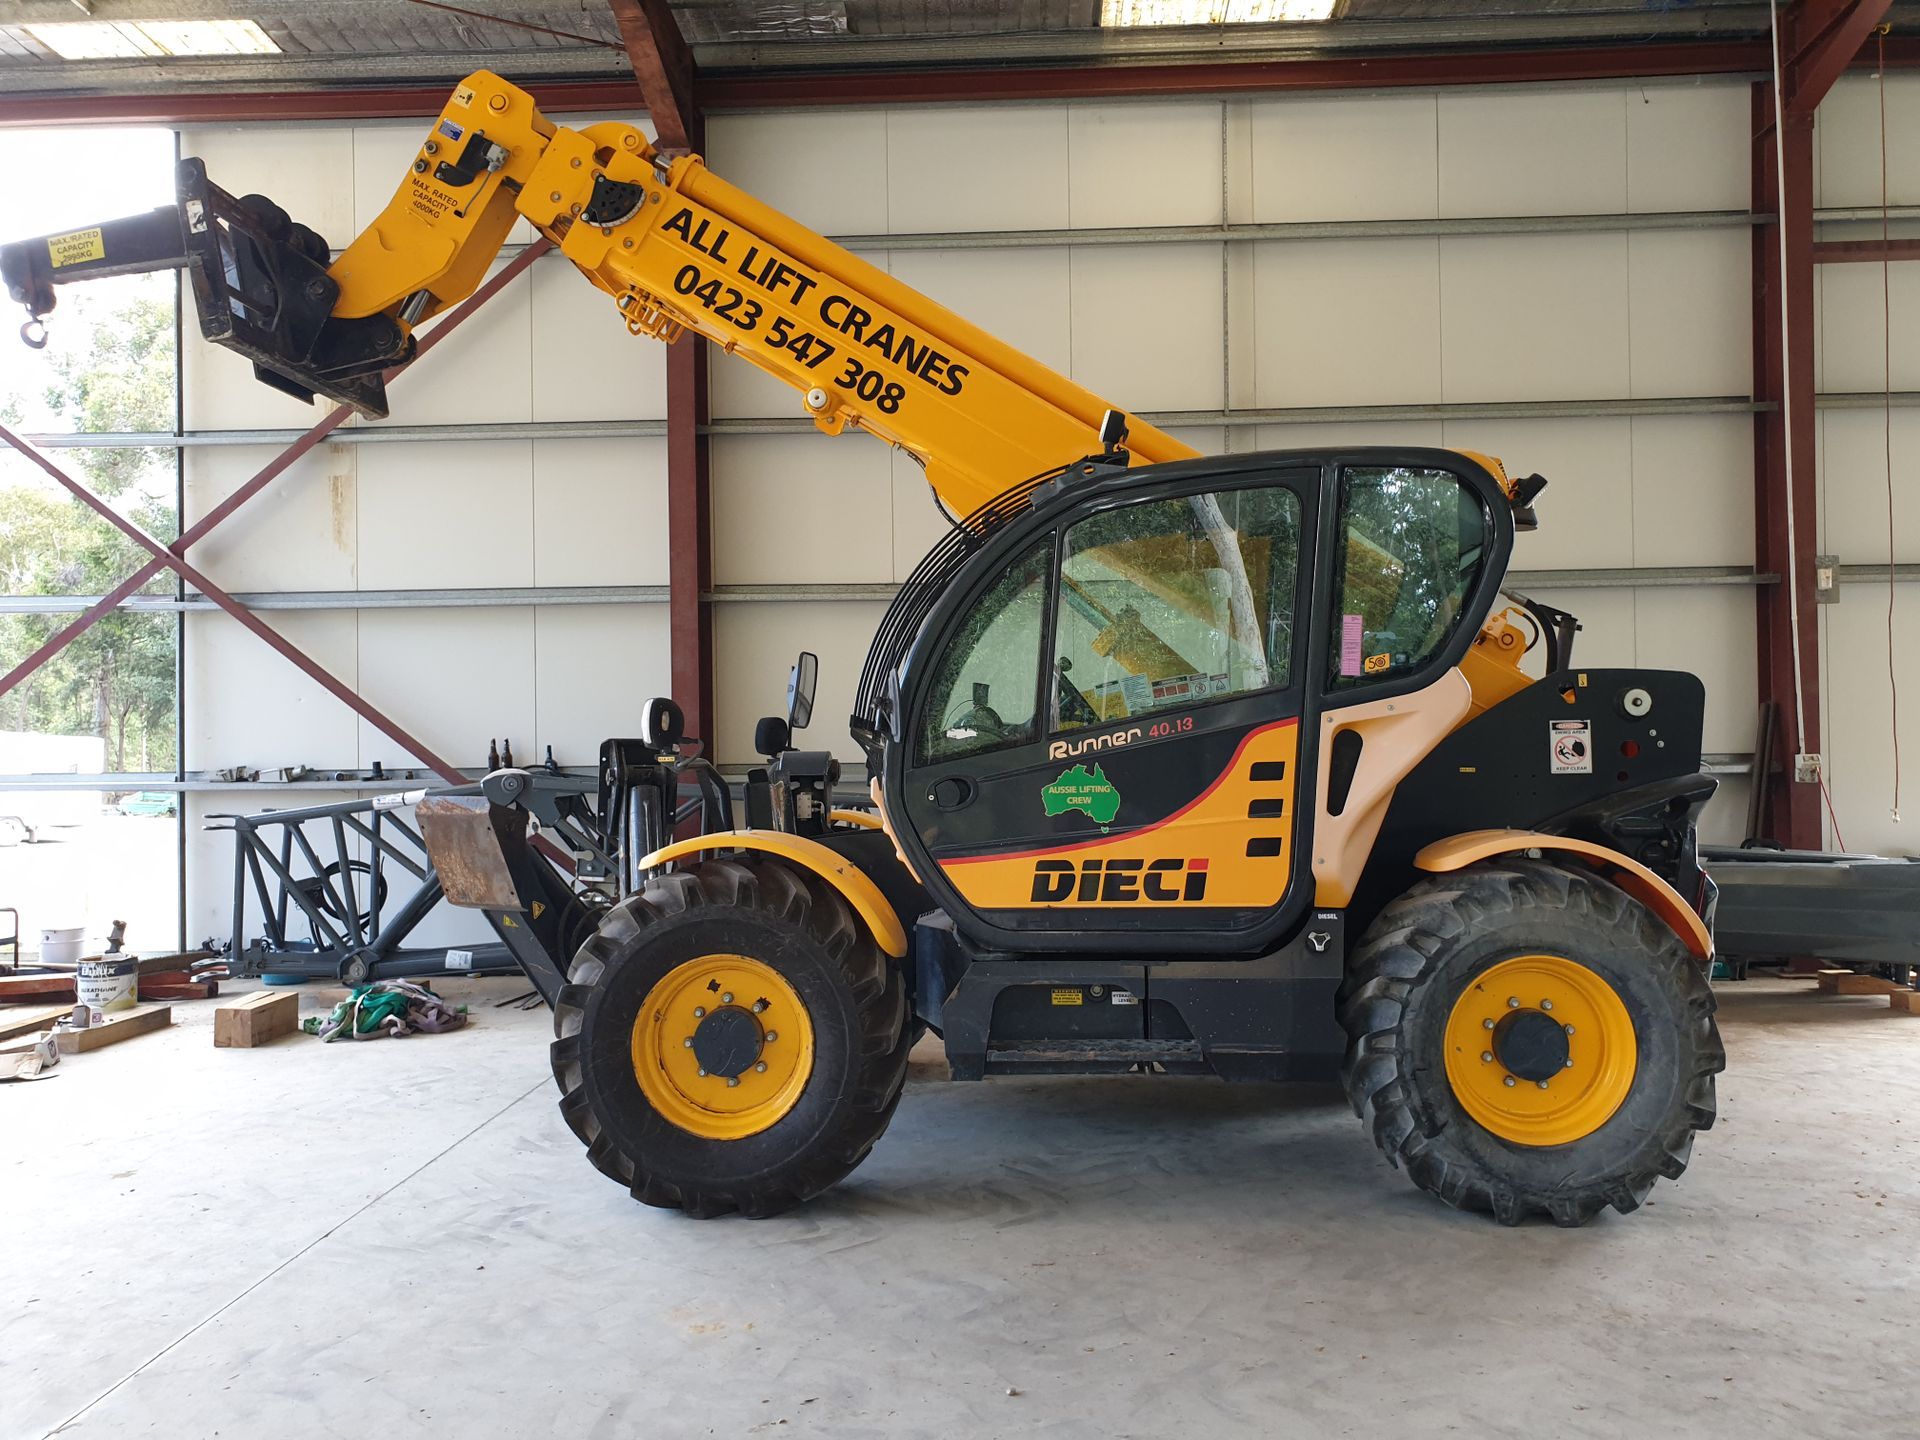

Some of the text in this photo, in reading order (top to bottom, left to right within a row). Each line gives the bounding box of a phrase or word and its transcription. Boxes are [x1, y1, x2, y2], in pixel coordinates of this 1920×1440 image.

[412, 189, 449, 212] CAPACITY
[432, 189, 458, 207] RATED
[412, 200, 441, 219] 4000KG
[71, 230, 99, 242] RATED
[56, 239, 95, 255] CAPACITY
[661, 207, 970, 396] ALL LIFT CRANES
[673, 264, 906, 415] 0423 547 308
[1148, 716, 1194, 738] 40.13
[1048, 784, 1111, 794] AUSSIE LIFTING
[1066, 796, 1093, 805] CREW
